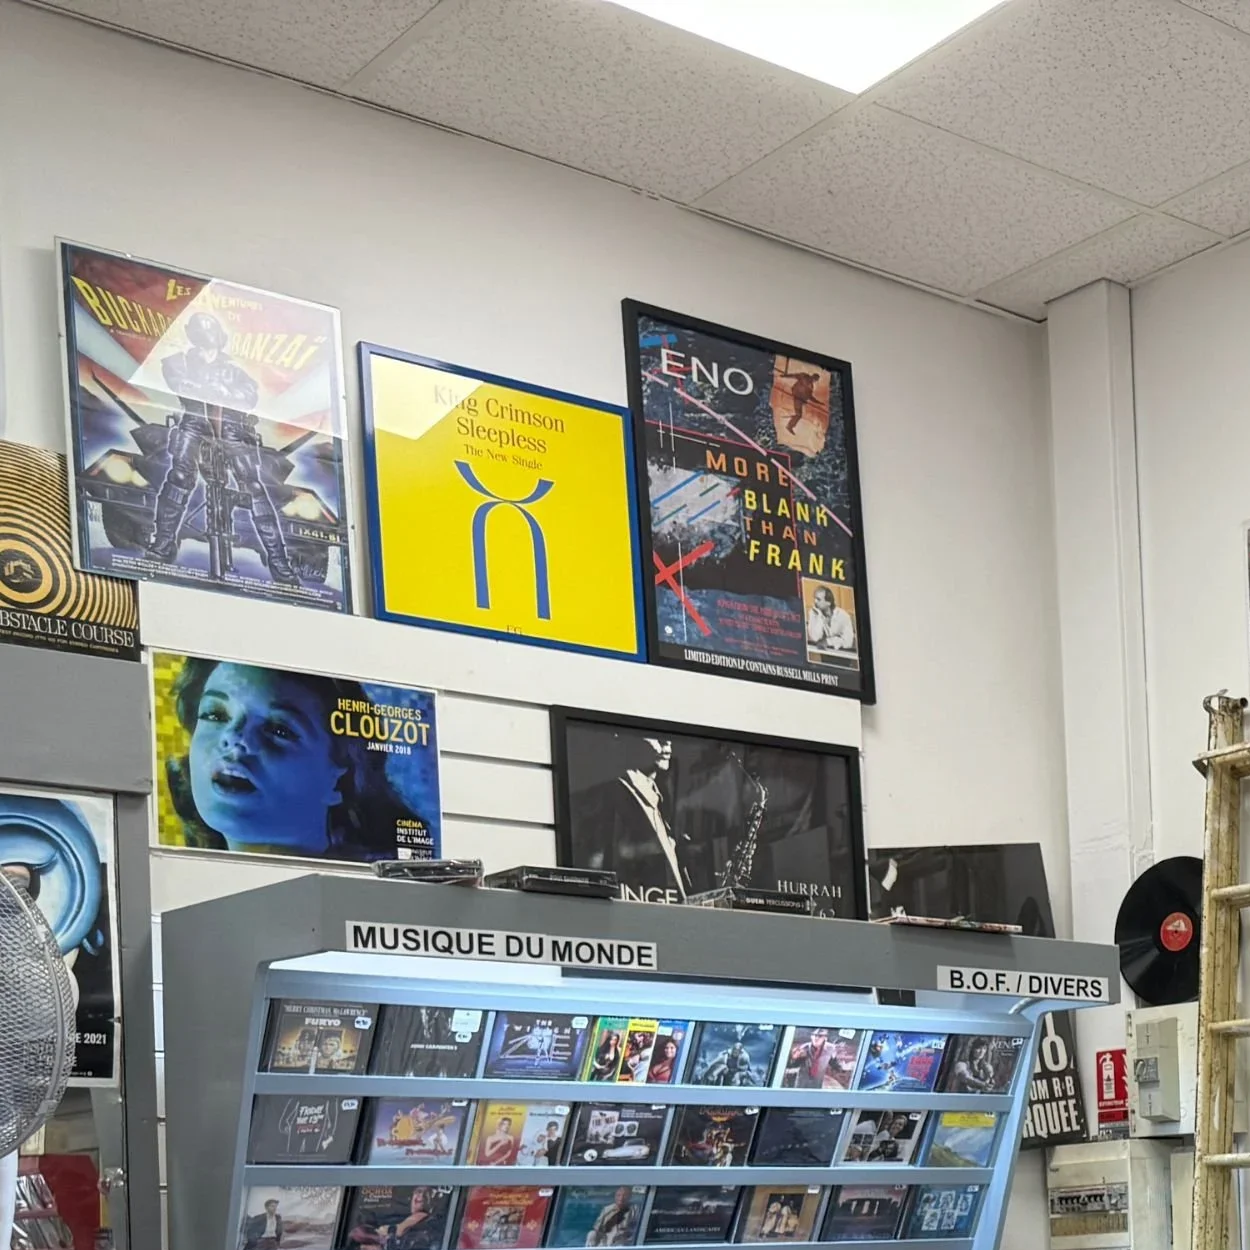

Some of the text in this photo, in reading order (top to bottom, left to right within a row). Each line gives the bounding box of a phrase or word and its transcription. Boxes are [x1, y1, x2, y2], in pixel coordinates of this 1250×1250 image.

[660, 348, 755, 397] ENO
[433, 384, 566, 434] King Crimson
[457, 417, 548, 455] Sleepless
[463, 444, 543, 471] The New Single
[705, 448, 791, 488] MORE
[744, 489, 831, 528] BLANK
[743, 515, 818, 547] THAN
[749, 539, 847, 582] FRANK
[0, 609, 68, 636] BSTACLE
[72, 622, 135, 648] COURSE
[684, 649, 840, 687] LIMITED EDITION LP CONTAINS RUSSELL MILLS PRINT
[330, 710, 431, 747] CLOUZOT
[337, 698, 423, 722] HENRI-GEORGES
[366, 741, 412, 756] JANVIER 2018
[396, 827, 428, 837] INSTITUT
[396, 836, 407, 844] DE
[776, 878, 843, 898] HURRAH
[351, 923, 655, 968] MUSIQUE DU MONDE
[949, 969, 1103, 999] B.O.F. / DIVERS
[83, 1031, 108, 1046] 2021
[1022, 1101, 1080, 1139] RQUEE
